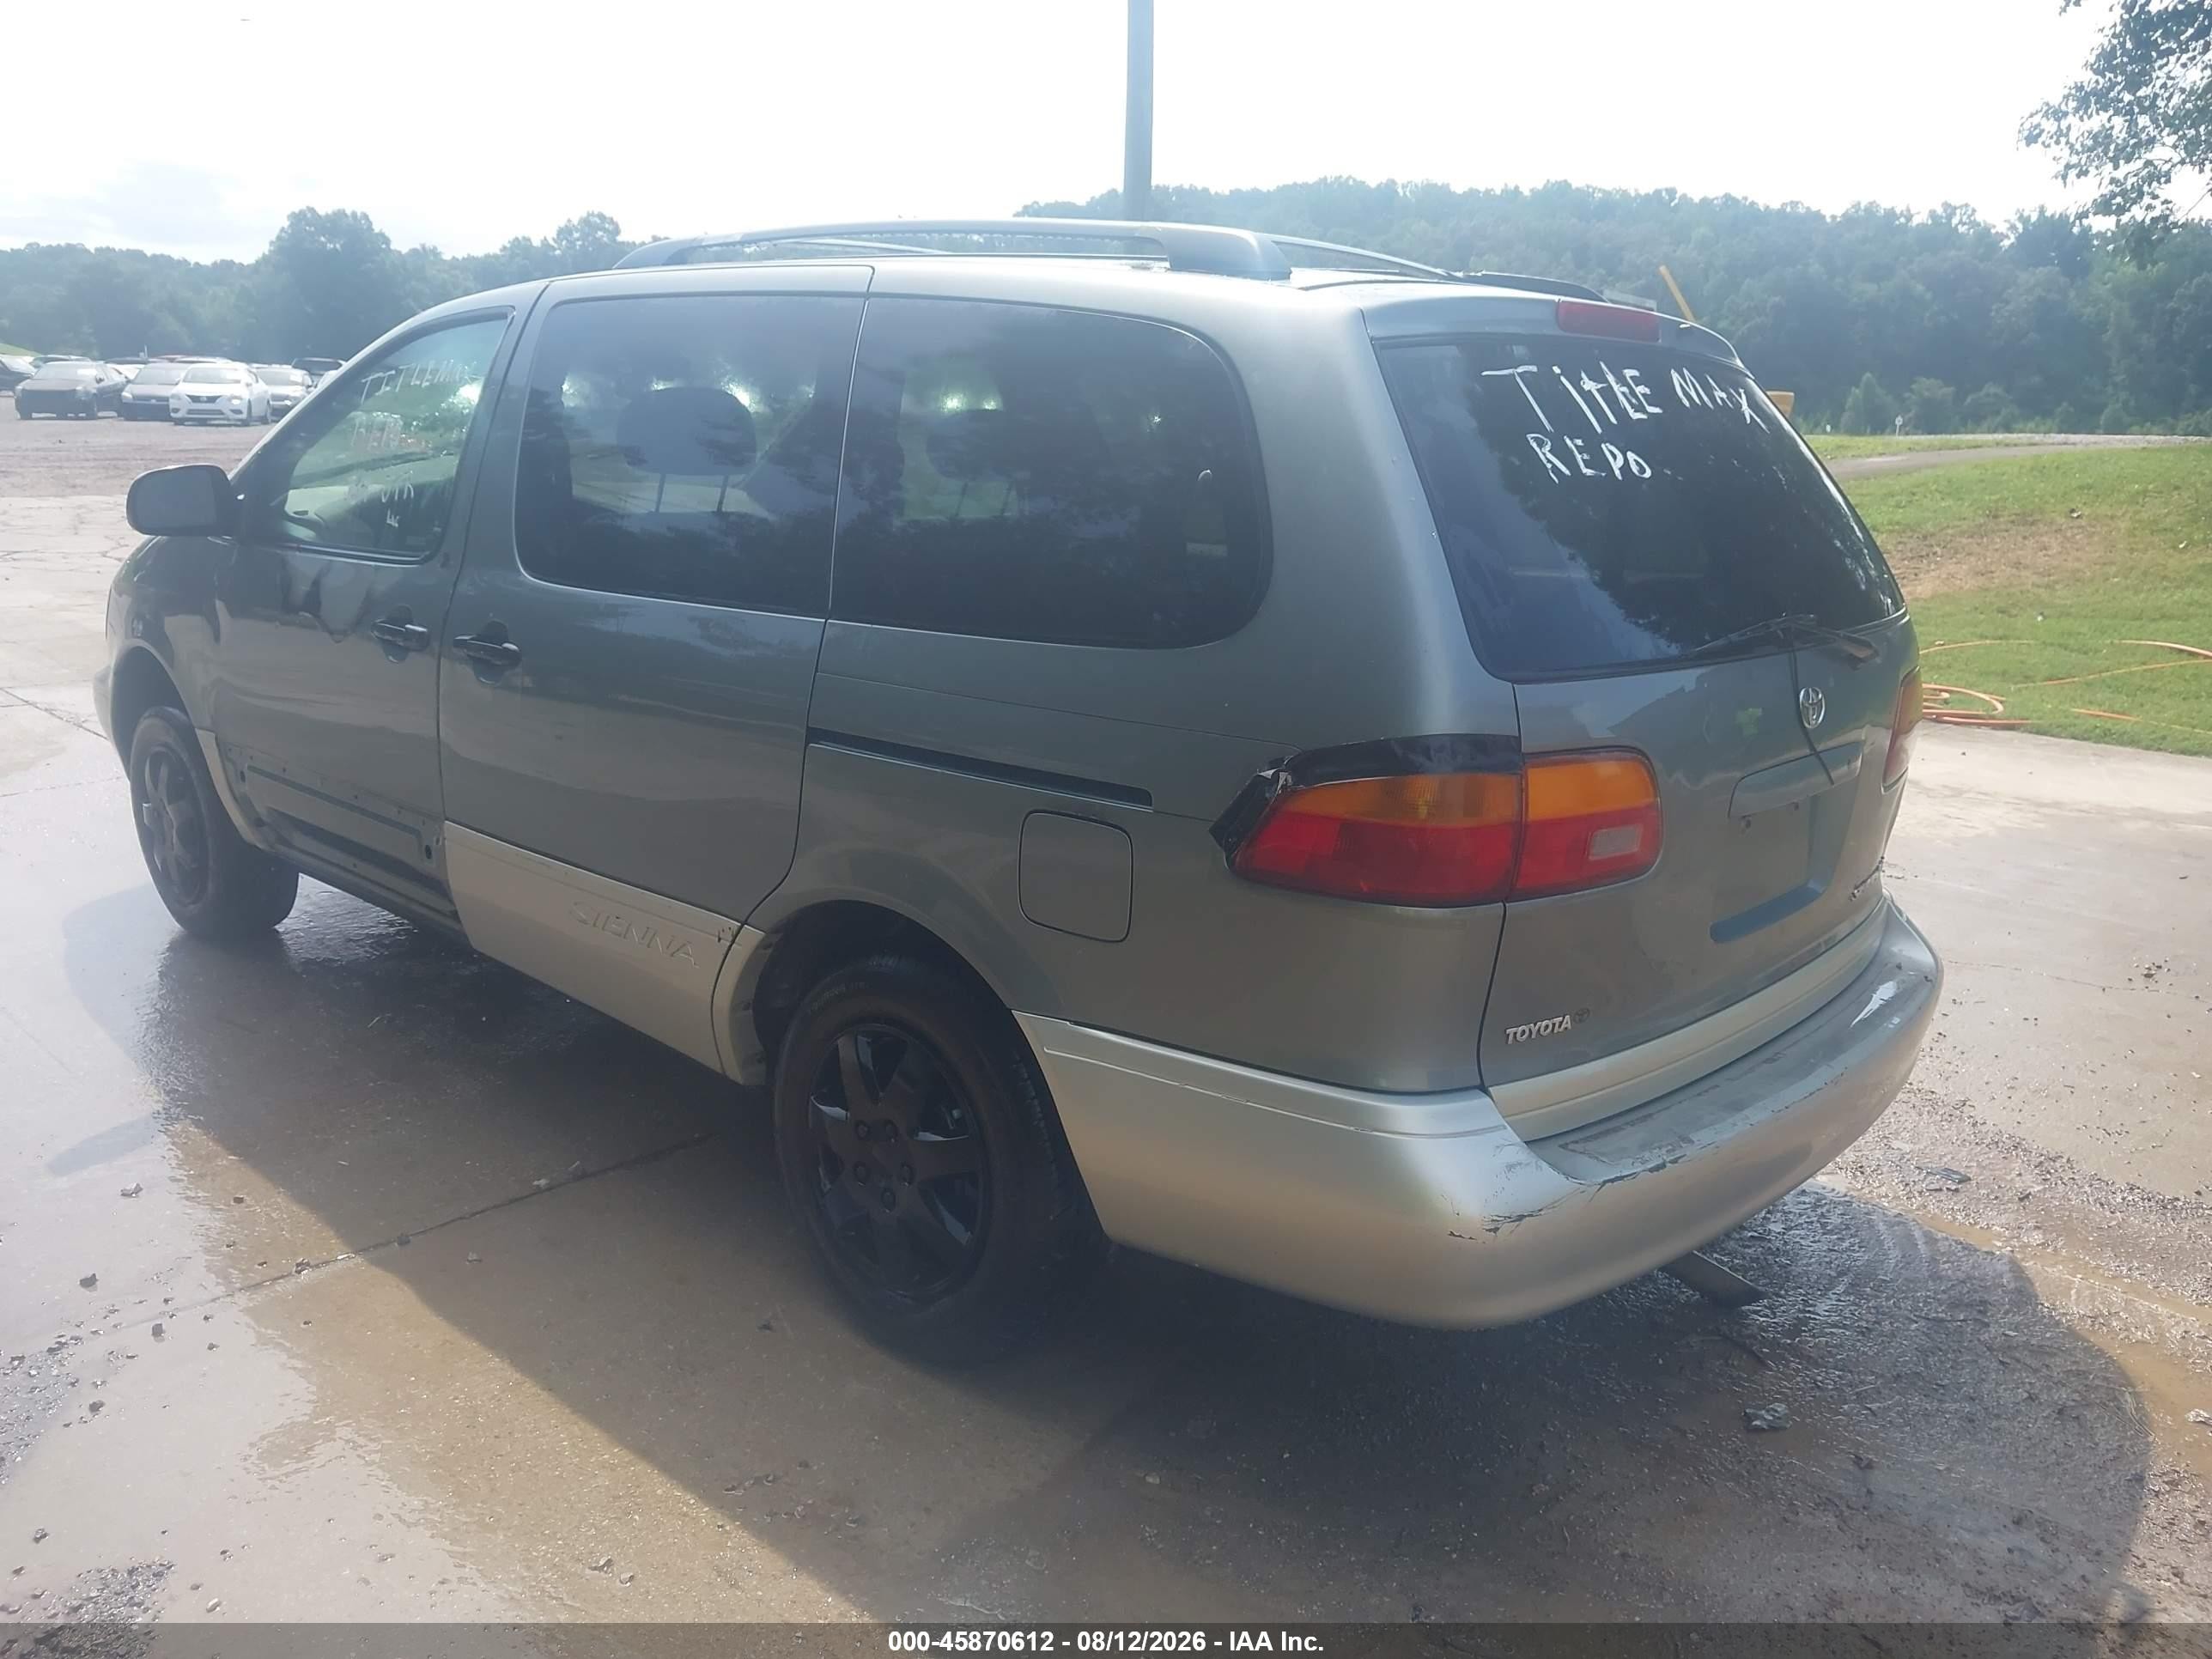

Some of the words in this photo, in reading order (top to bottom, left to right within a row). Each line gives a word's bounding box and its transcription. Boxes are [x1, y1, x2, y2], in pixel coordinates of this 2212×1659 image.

[1670, 367, 1771, 434] MAX
[1526, 433, 1652, 483] REPO
[568, 901, 701, 969] SIENNA
[1505, 1015, 1571, 1044] TOYOTA
